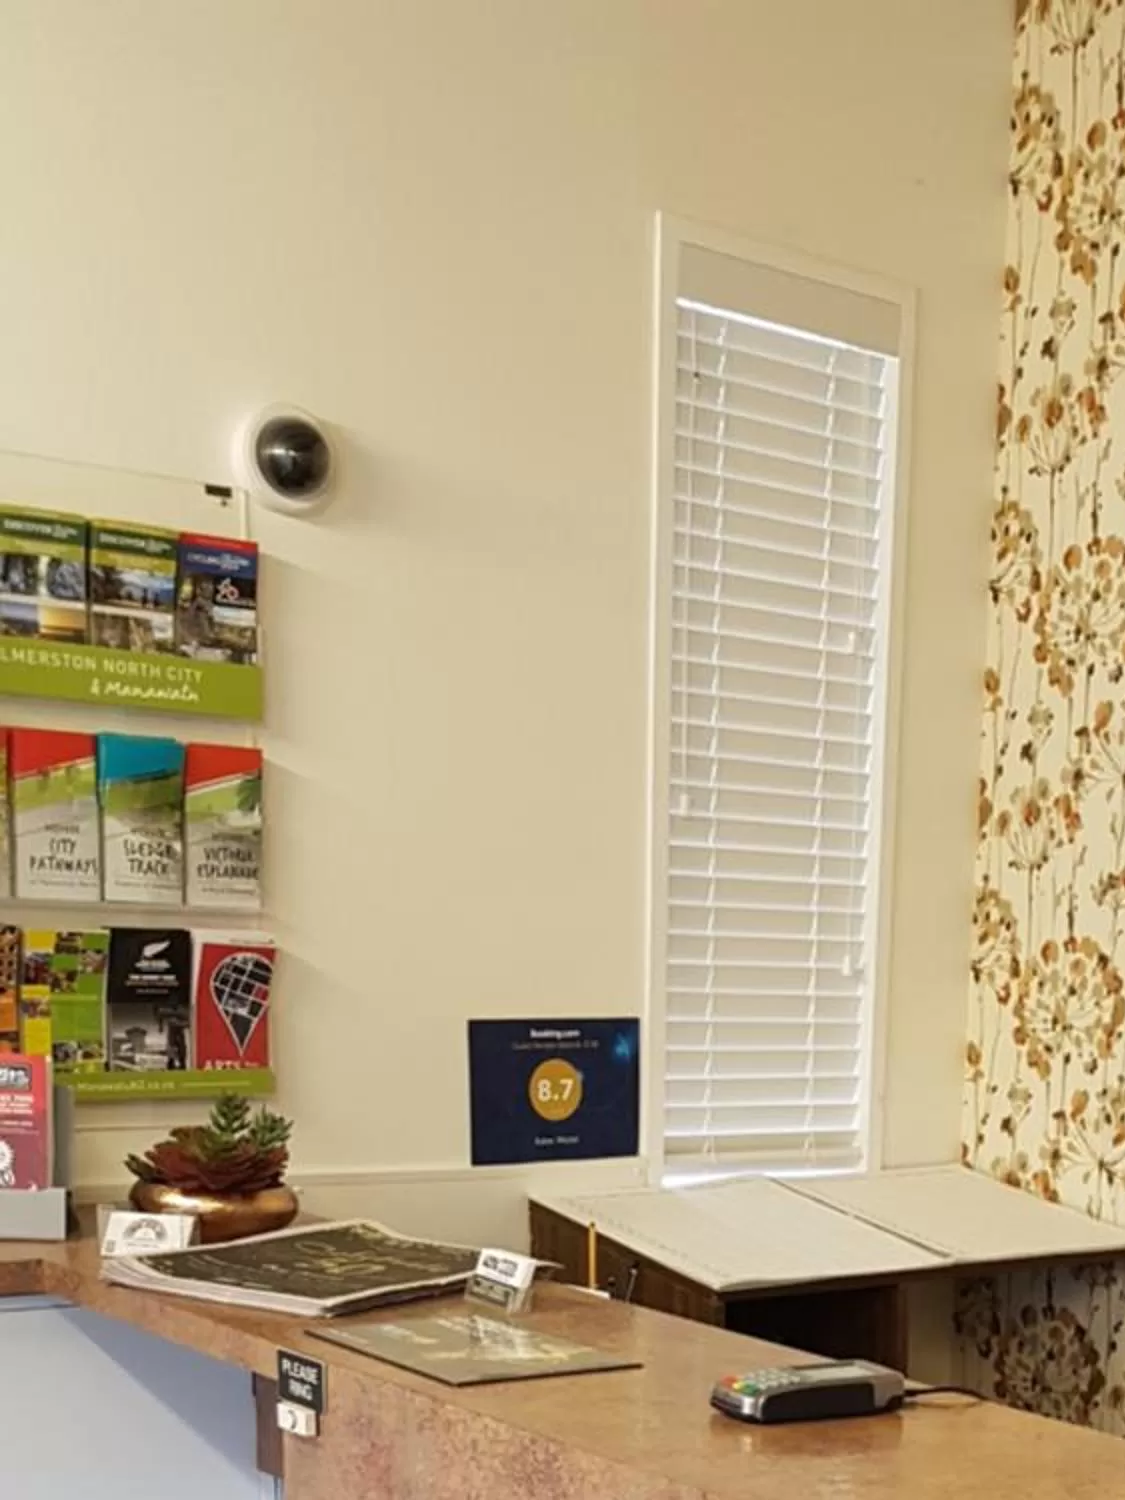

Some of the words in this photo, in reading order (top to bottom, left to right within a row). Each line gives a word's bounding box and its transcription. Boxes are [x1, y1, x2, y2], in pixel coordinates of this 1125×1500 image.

[103, 658, 162, 679] NORTH
[165, 666, 203, 683] CITY
[537, 1078, 574, 1101] 8.7
[281, 1357, 318, 1385] PLEASE
[288, 1379, 313, 1401] RING
